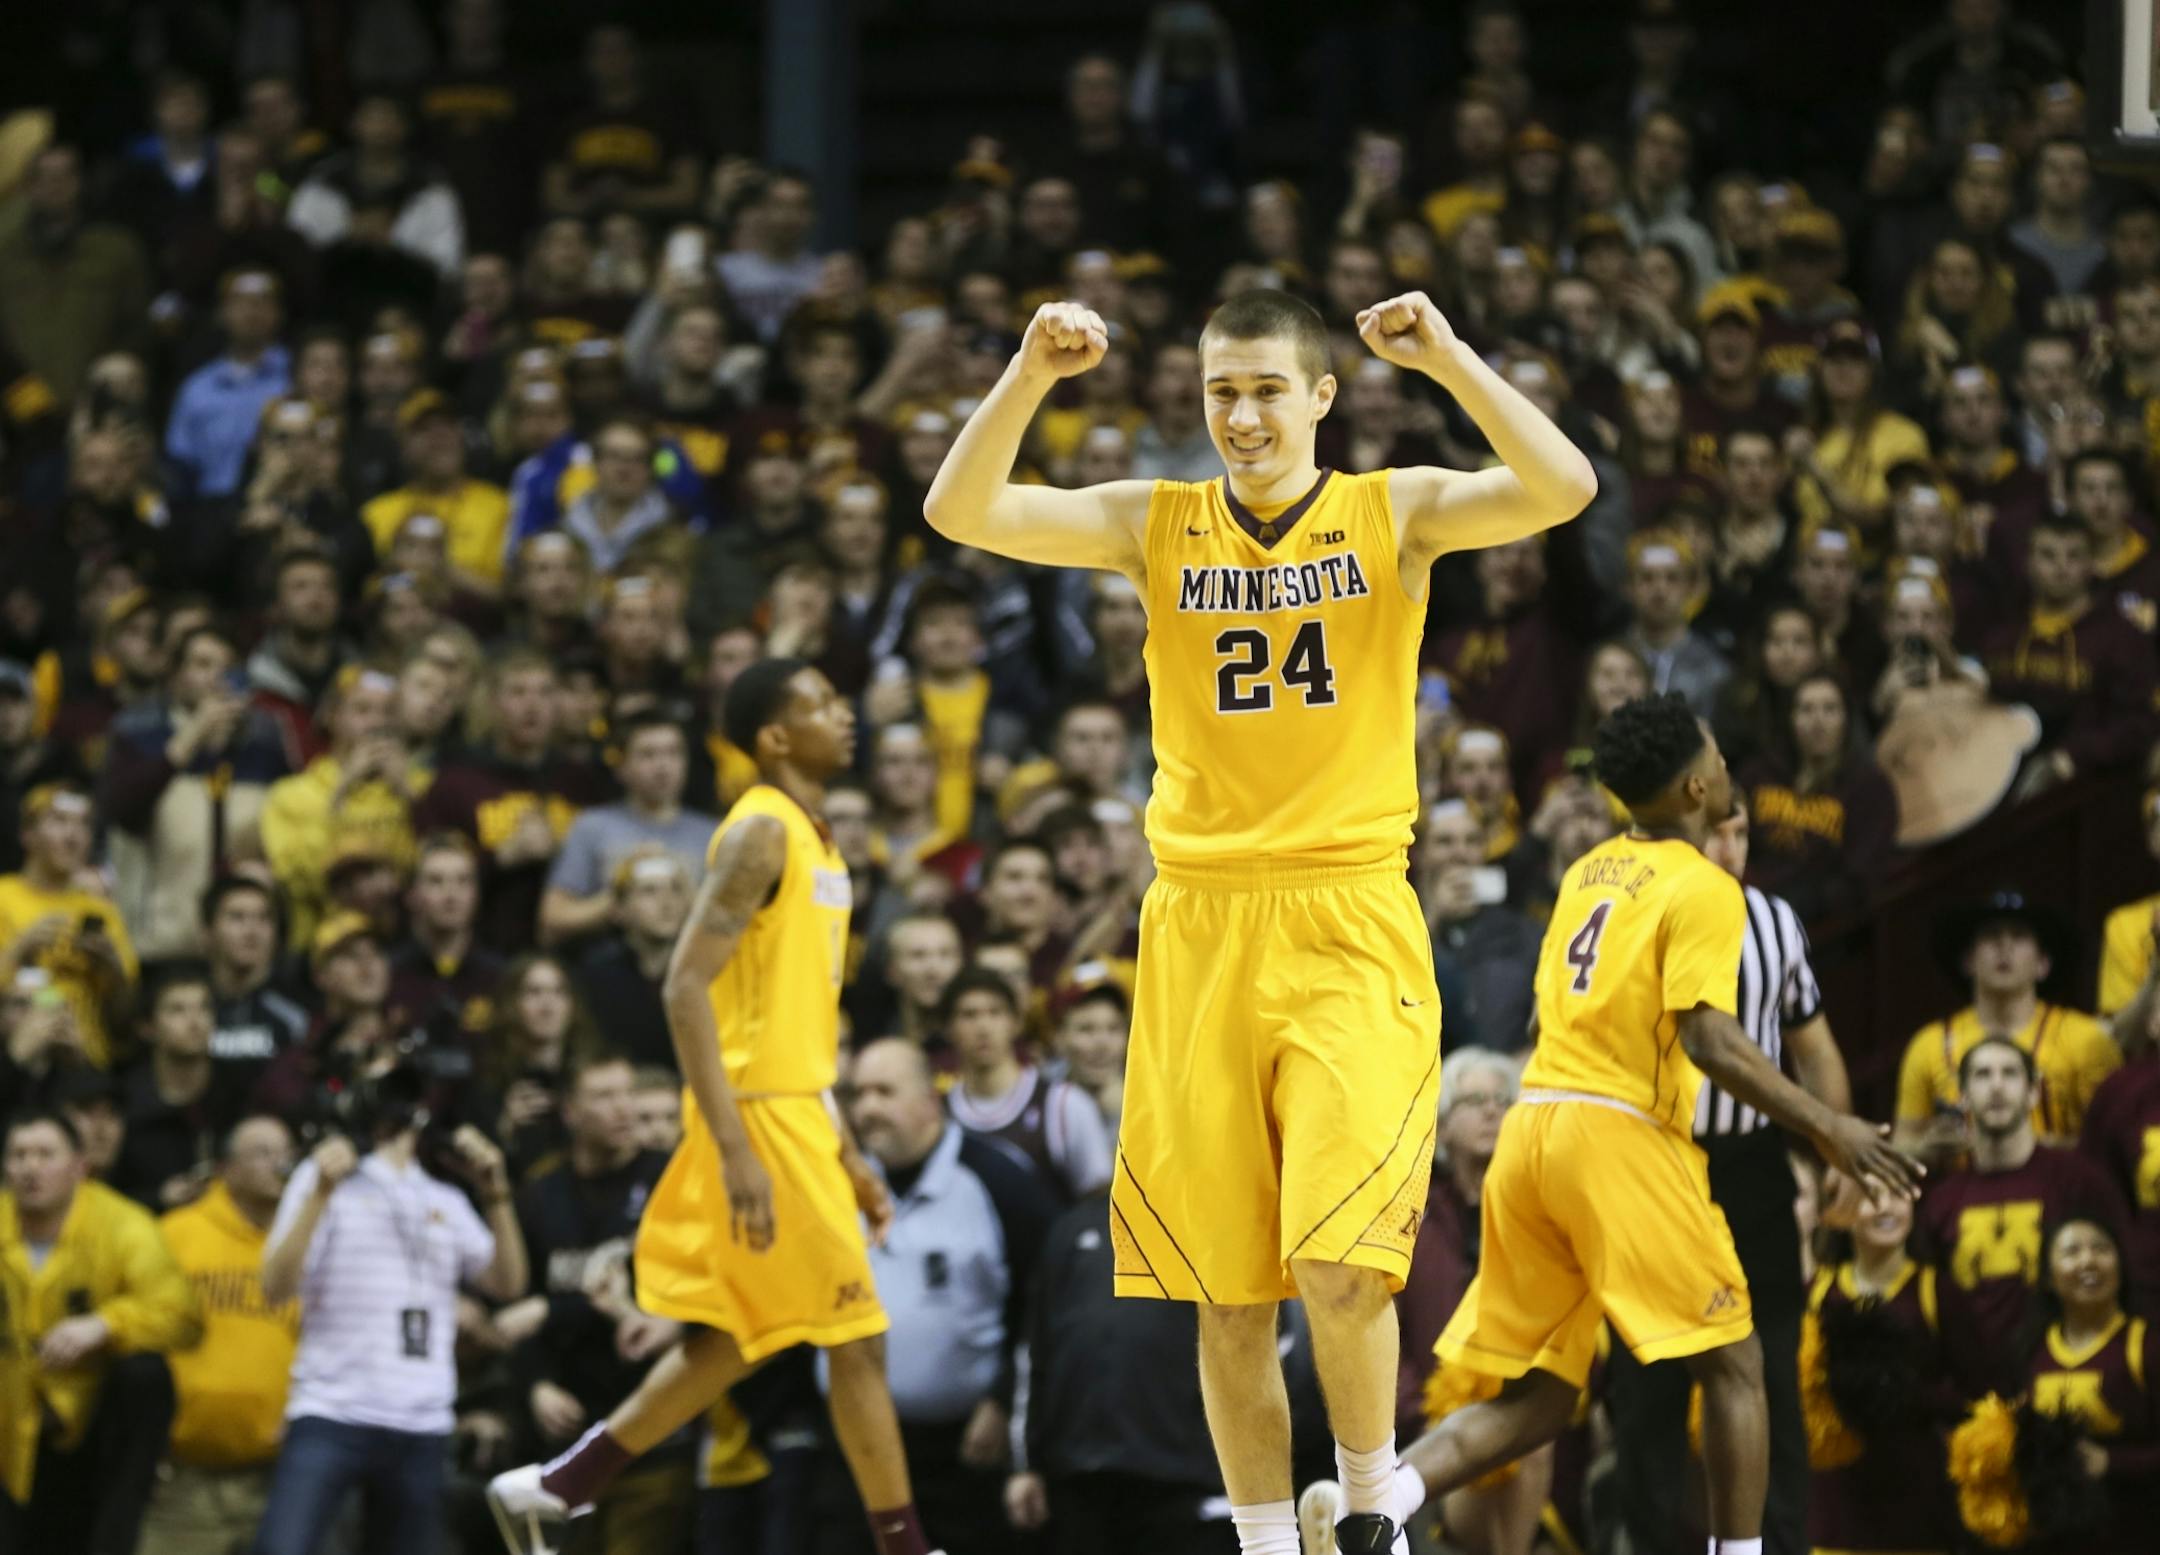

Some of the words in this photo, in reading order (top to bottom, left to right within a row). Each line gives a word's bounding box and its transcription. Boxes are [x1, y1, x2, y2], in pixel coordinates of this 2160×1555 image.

[1177, 551, 1370, 613] MINNESOTA
[1215, 618, 1337, 714] 24
[1567, 899, 1614, 994] 4
[1953, 1200, 2043, 1291] M
